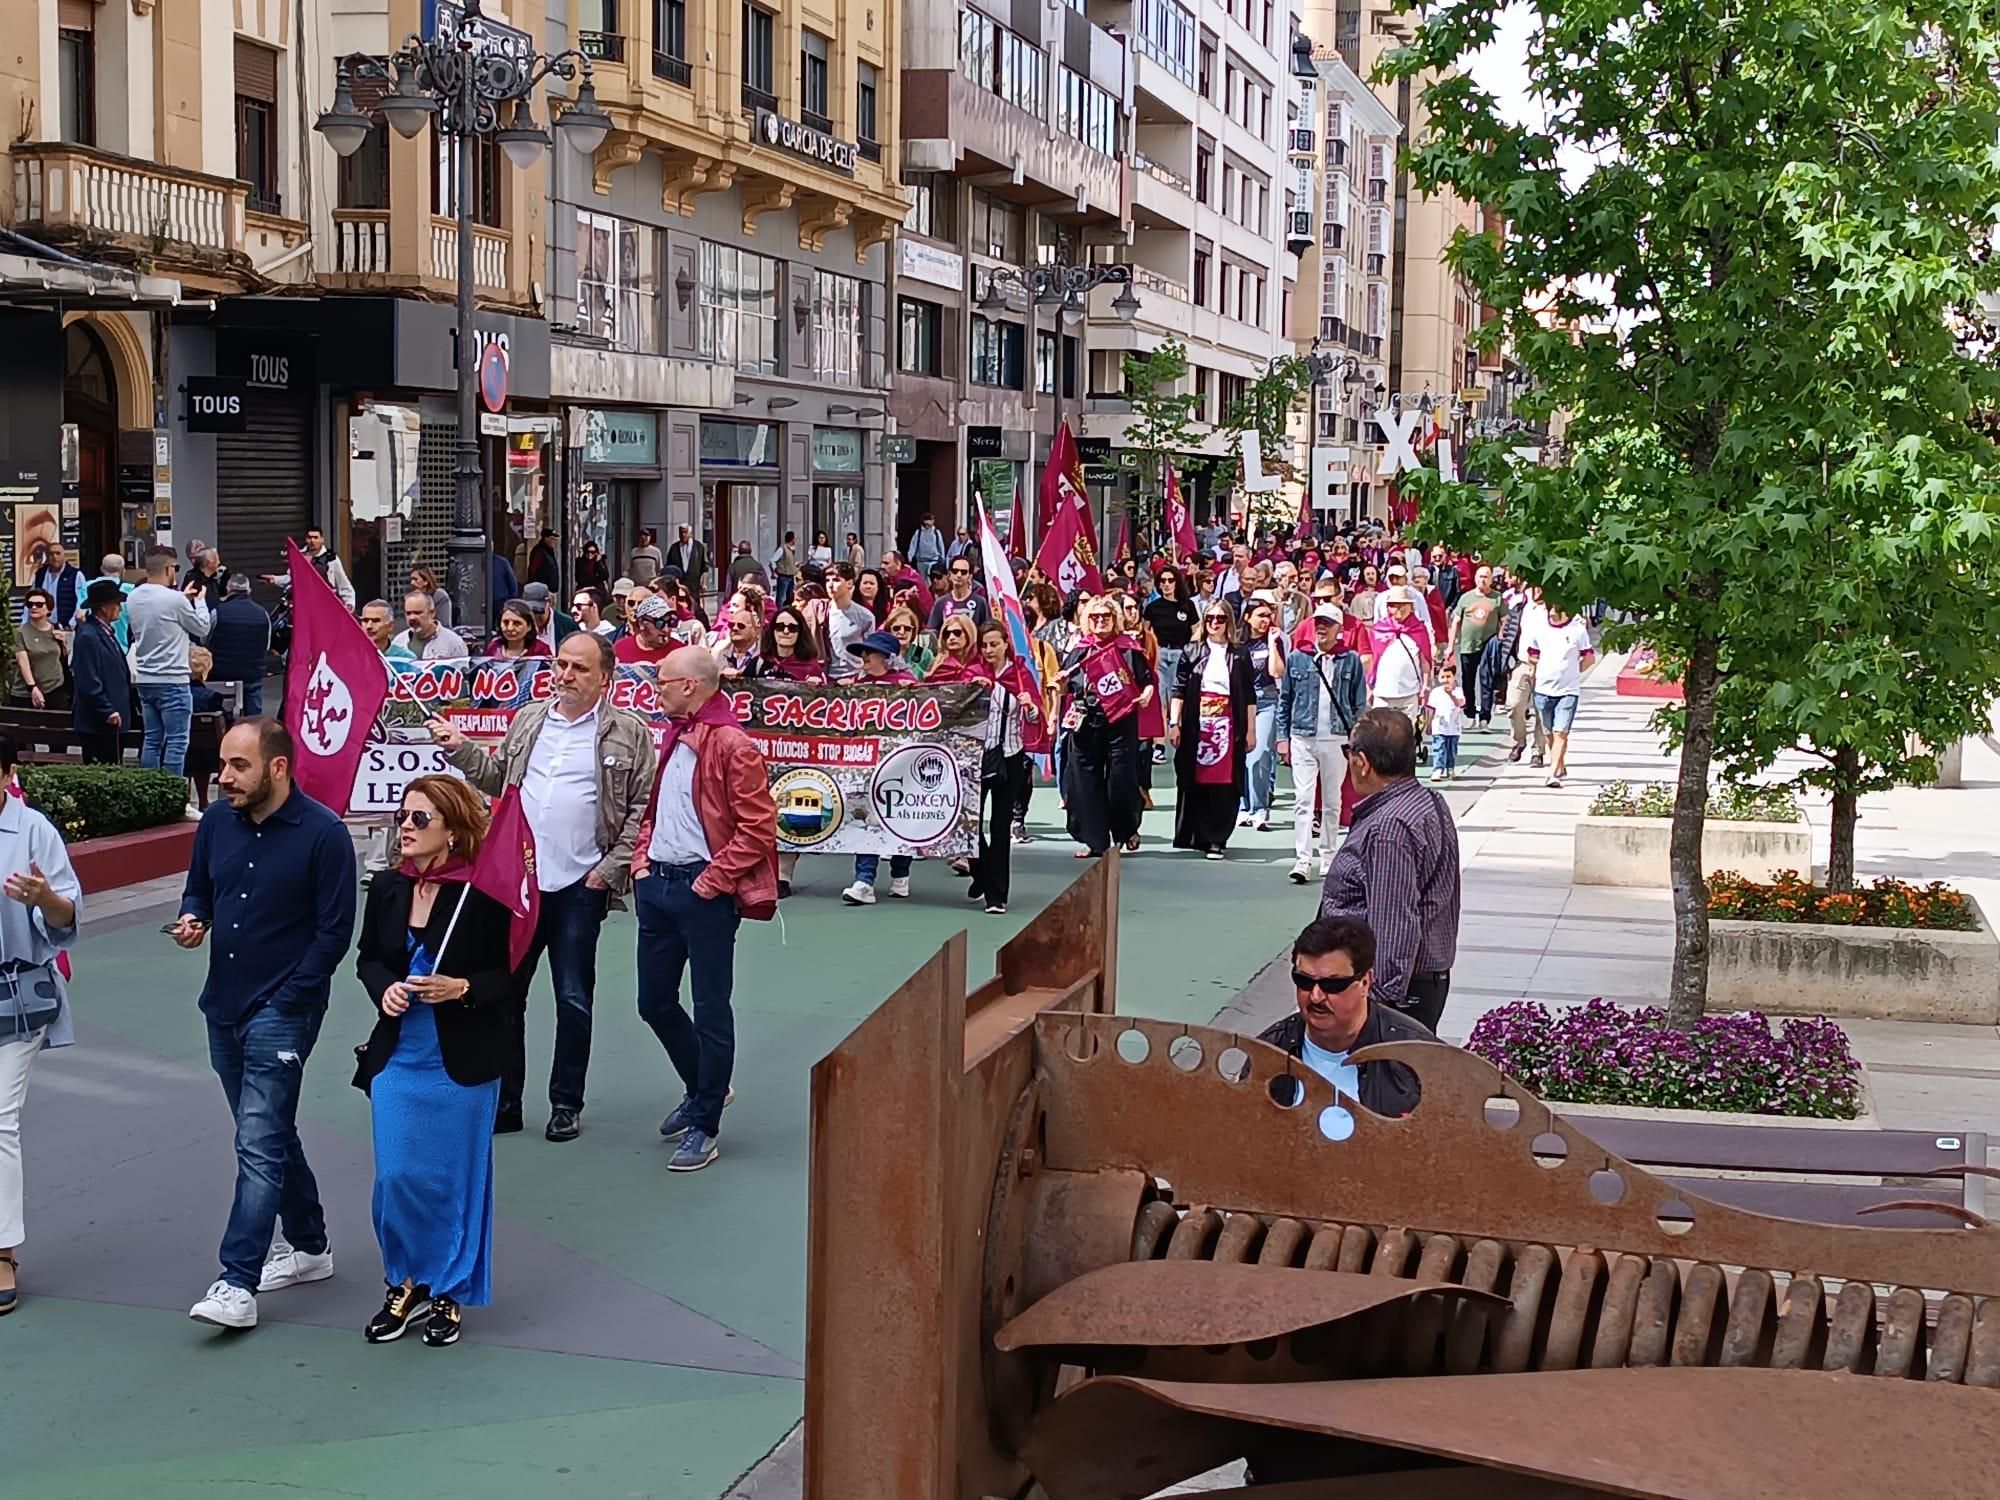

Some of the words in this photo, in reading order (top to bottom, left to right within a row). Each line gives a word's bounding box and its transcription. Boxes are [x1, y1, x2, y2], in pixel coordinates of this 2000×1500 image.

[250, 354, 288, 383] TOUS
[192, 395, 240, 414] TOUS
[386, 661, 462, 702] EÓN
[471, 668, 519, 701] NO
[763, 694, 942, 731] SACRIFICIO
[817, 743, 841, 761] STOP
